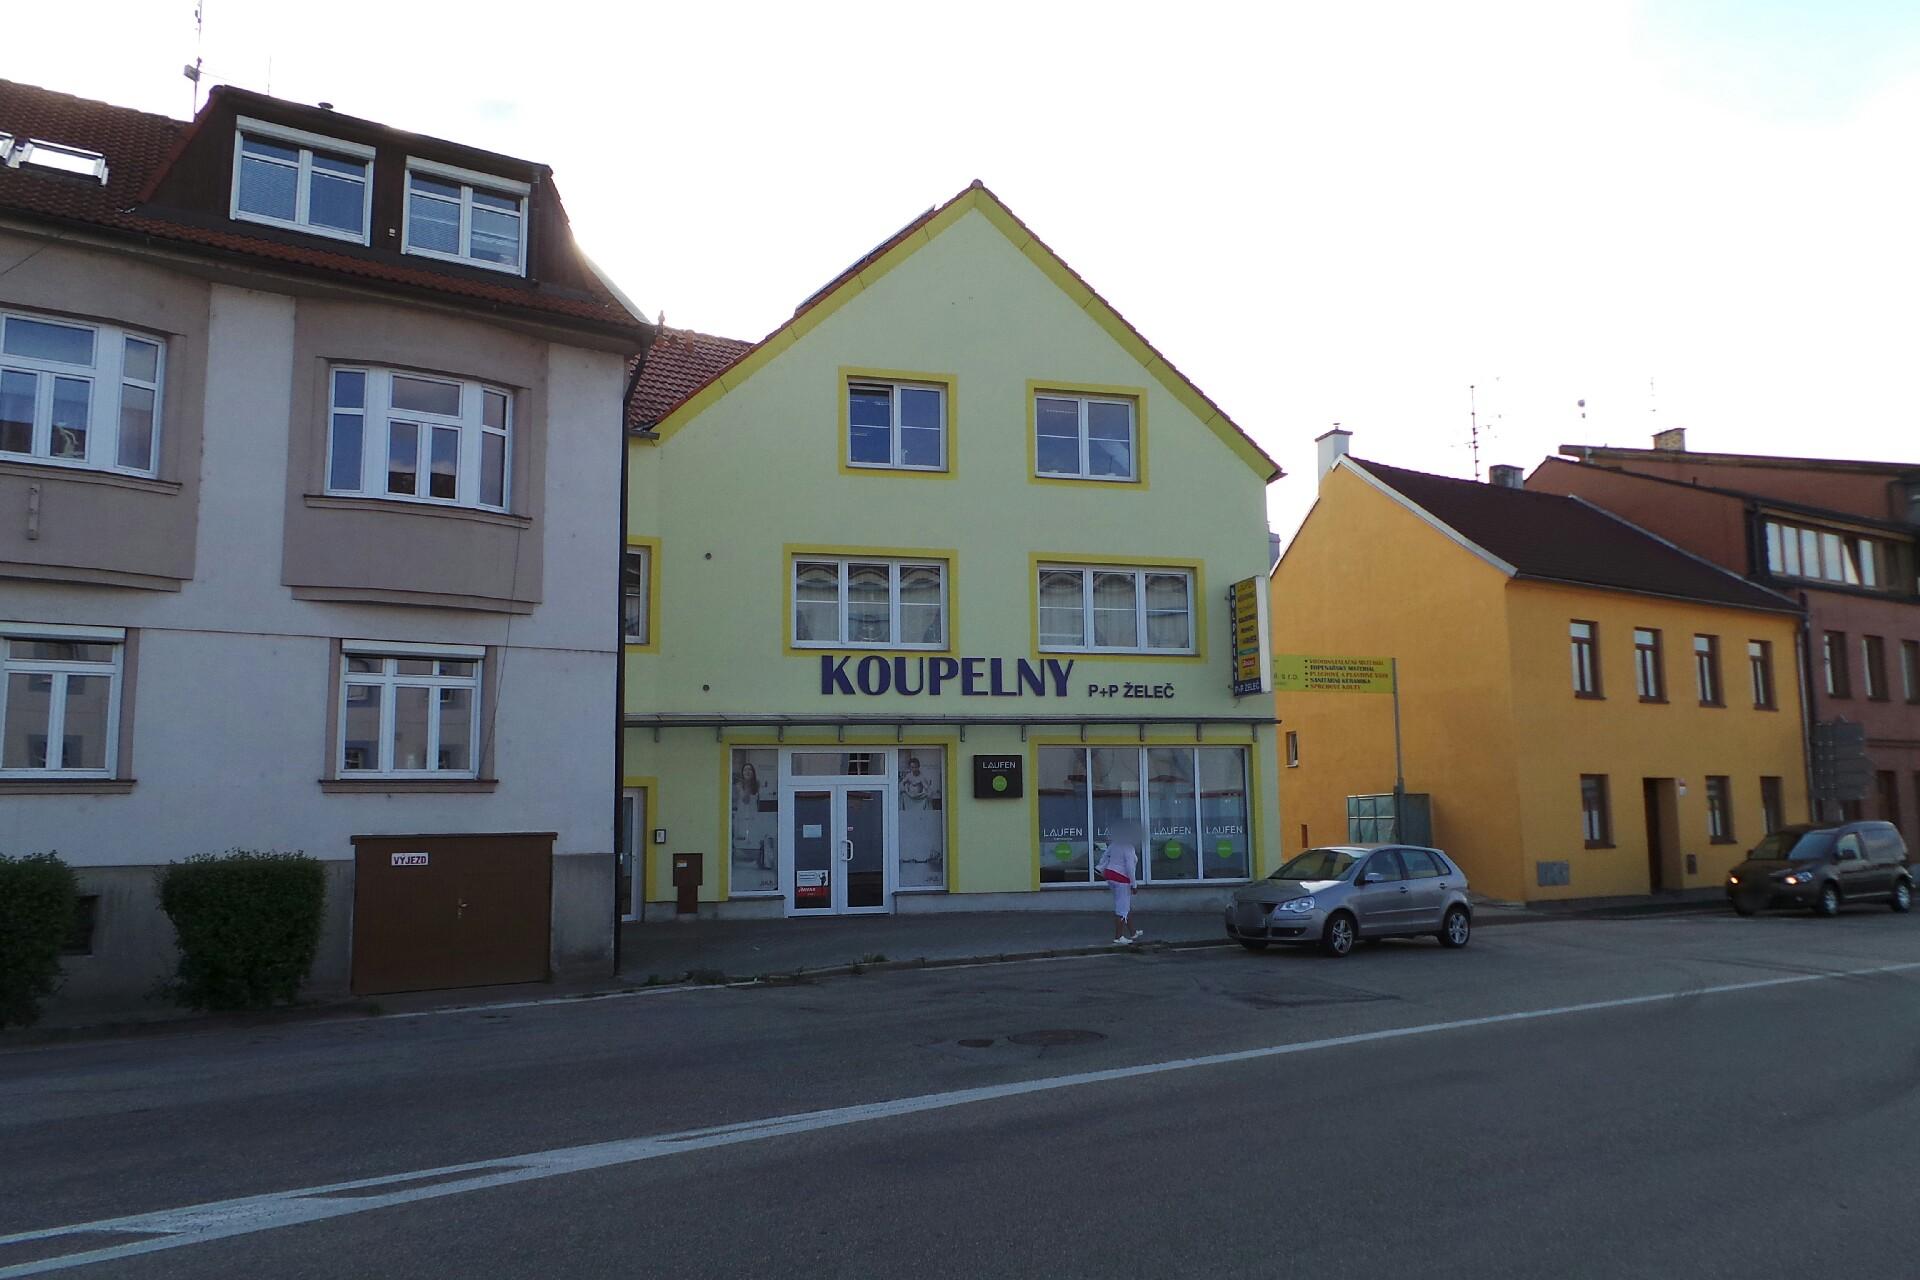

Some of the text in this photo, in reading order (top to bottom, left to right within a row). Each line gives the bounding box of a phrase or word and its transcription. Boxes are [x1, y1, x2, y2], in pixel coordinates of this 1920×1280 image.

[821, 655, 1074, 697] KOUPELNY
[1088, 681, 1175, 699] P+P ŽELEČ
[982, 761, 1016, 769] LAUFEN
[1043, 827, 1083, 837] LAUFEN
[1154, 826, 1192, 835] LAUFEN
[1206, 825, 1243, 834] LAUFEN
[394, 854, 427, 865] VÝJEZD
